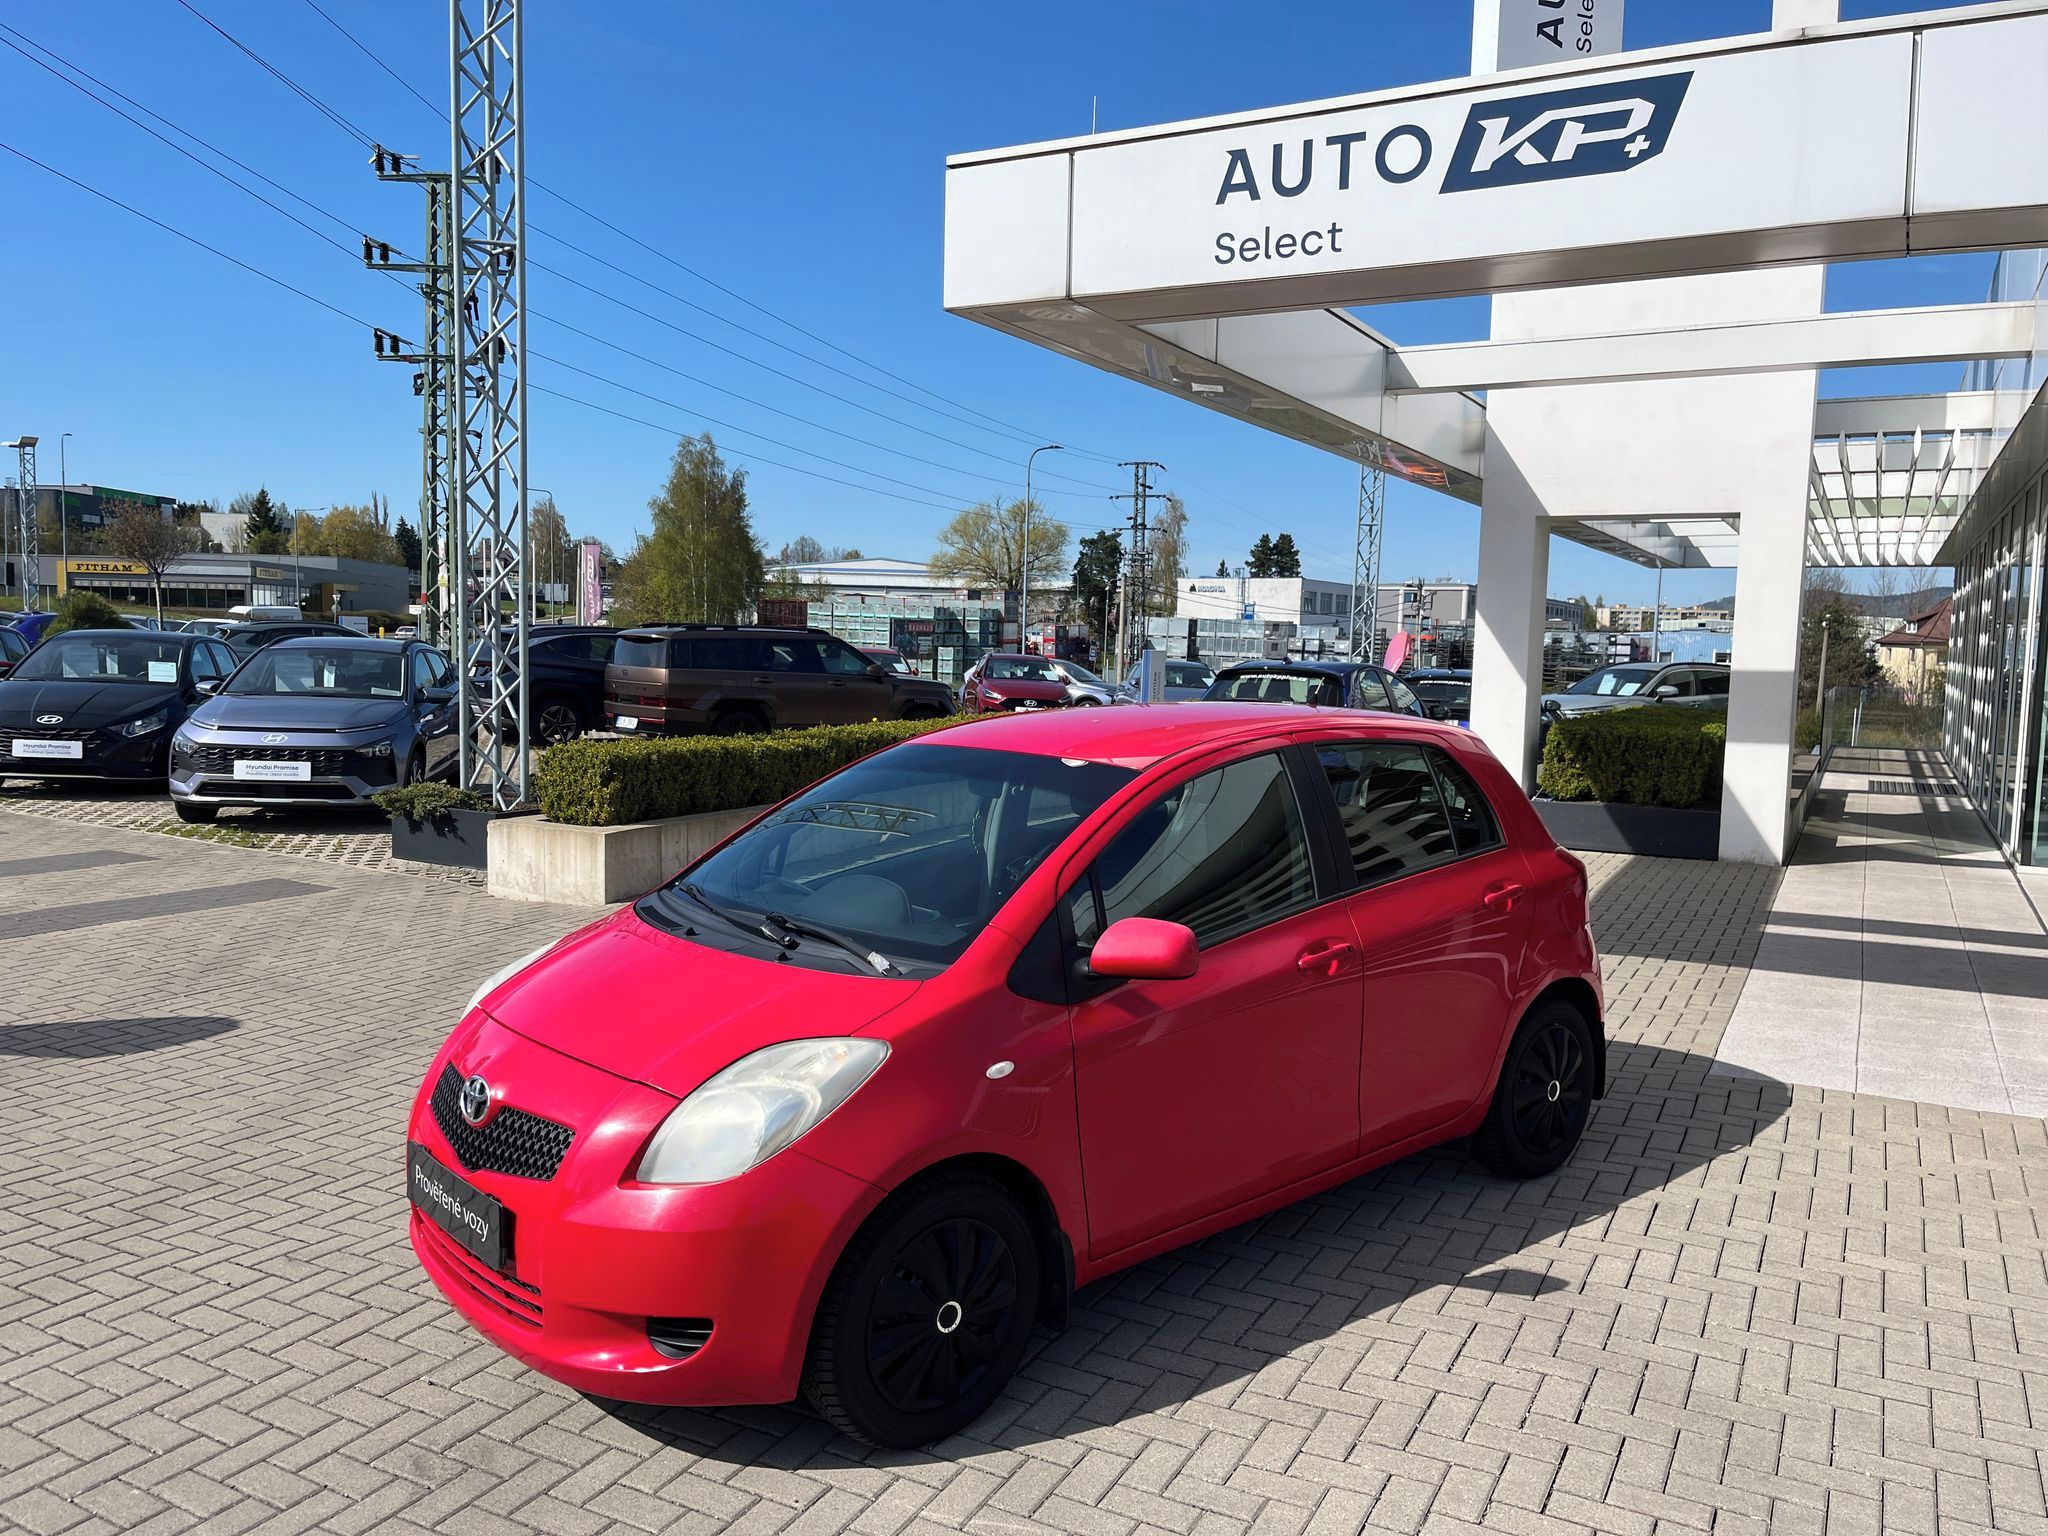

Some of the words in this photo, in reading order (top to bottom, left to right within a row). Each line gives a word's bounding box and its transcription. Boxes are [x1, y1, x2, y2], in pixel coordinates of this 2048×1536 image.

[1215, 123, 1433, 206] AUTO
[1213, 222, 1344, 265] Select
[76, 563, 134, 572] FITHAM
[415, 1164, 461, 1219] Prověřené
[463, 1207, 489, 1242] vozy
